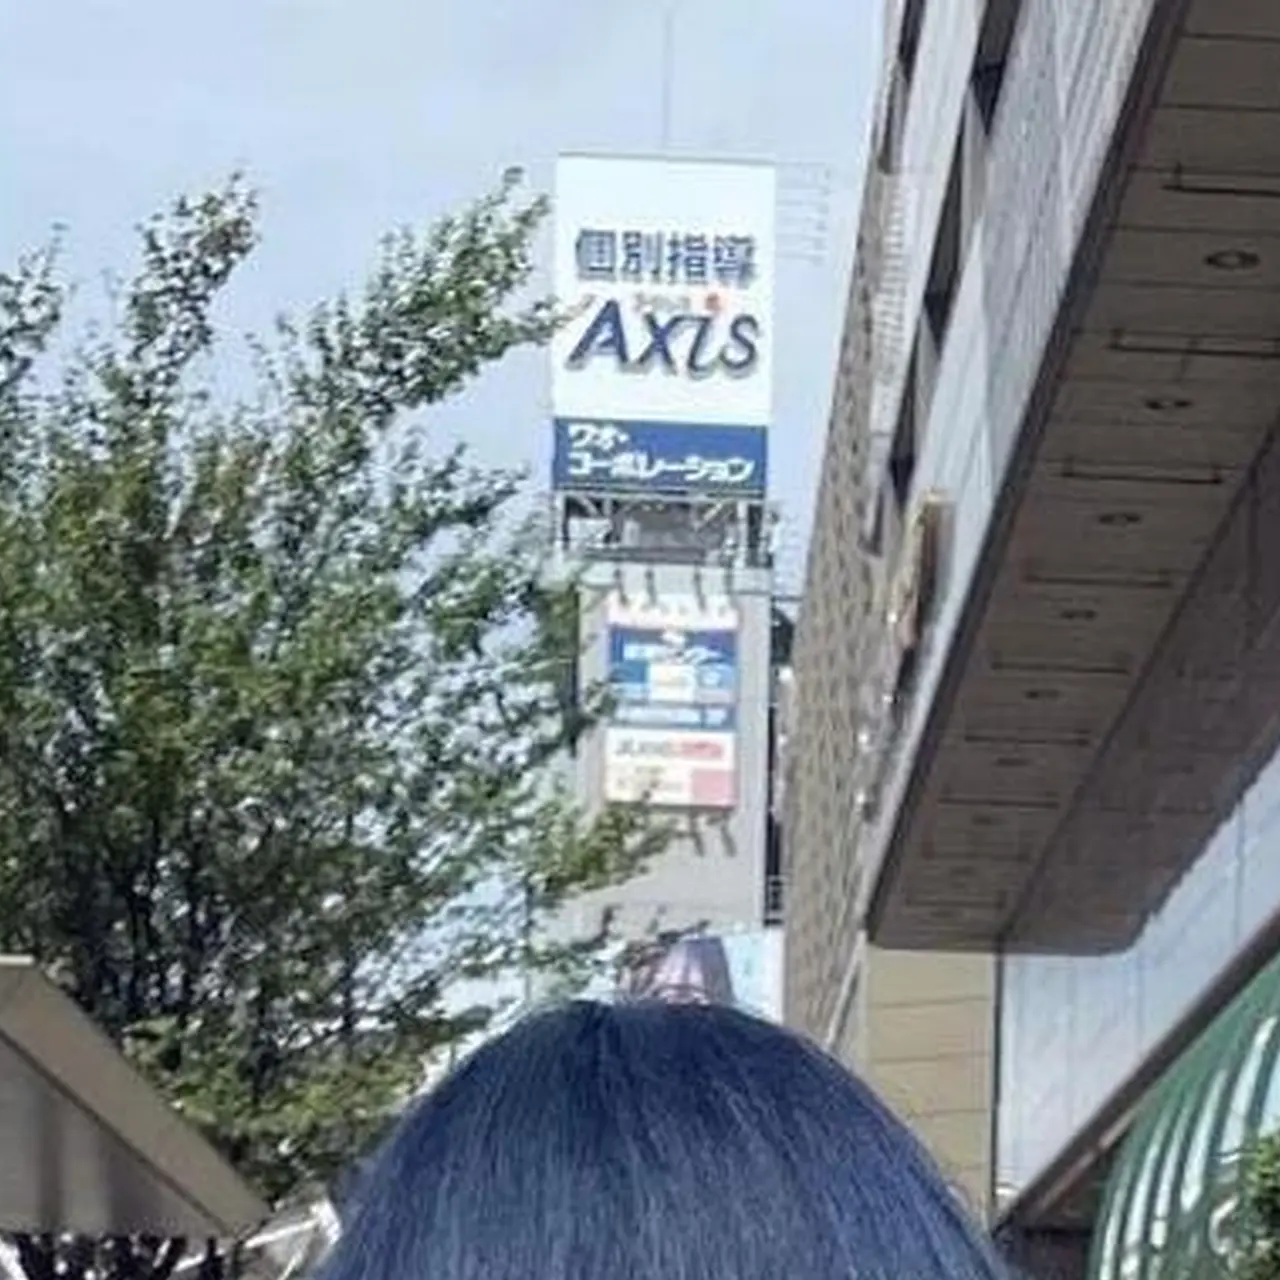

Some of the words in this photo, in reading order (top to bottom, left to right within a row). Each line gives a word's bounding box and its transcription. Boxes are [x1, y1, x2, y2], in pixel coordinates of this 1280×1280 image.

[575, 229, 757, 284] 個別指導
[566, 294, 760, 377] Axis
[568, 451, 755, 482] コーポレーション
